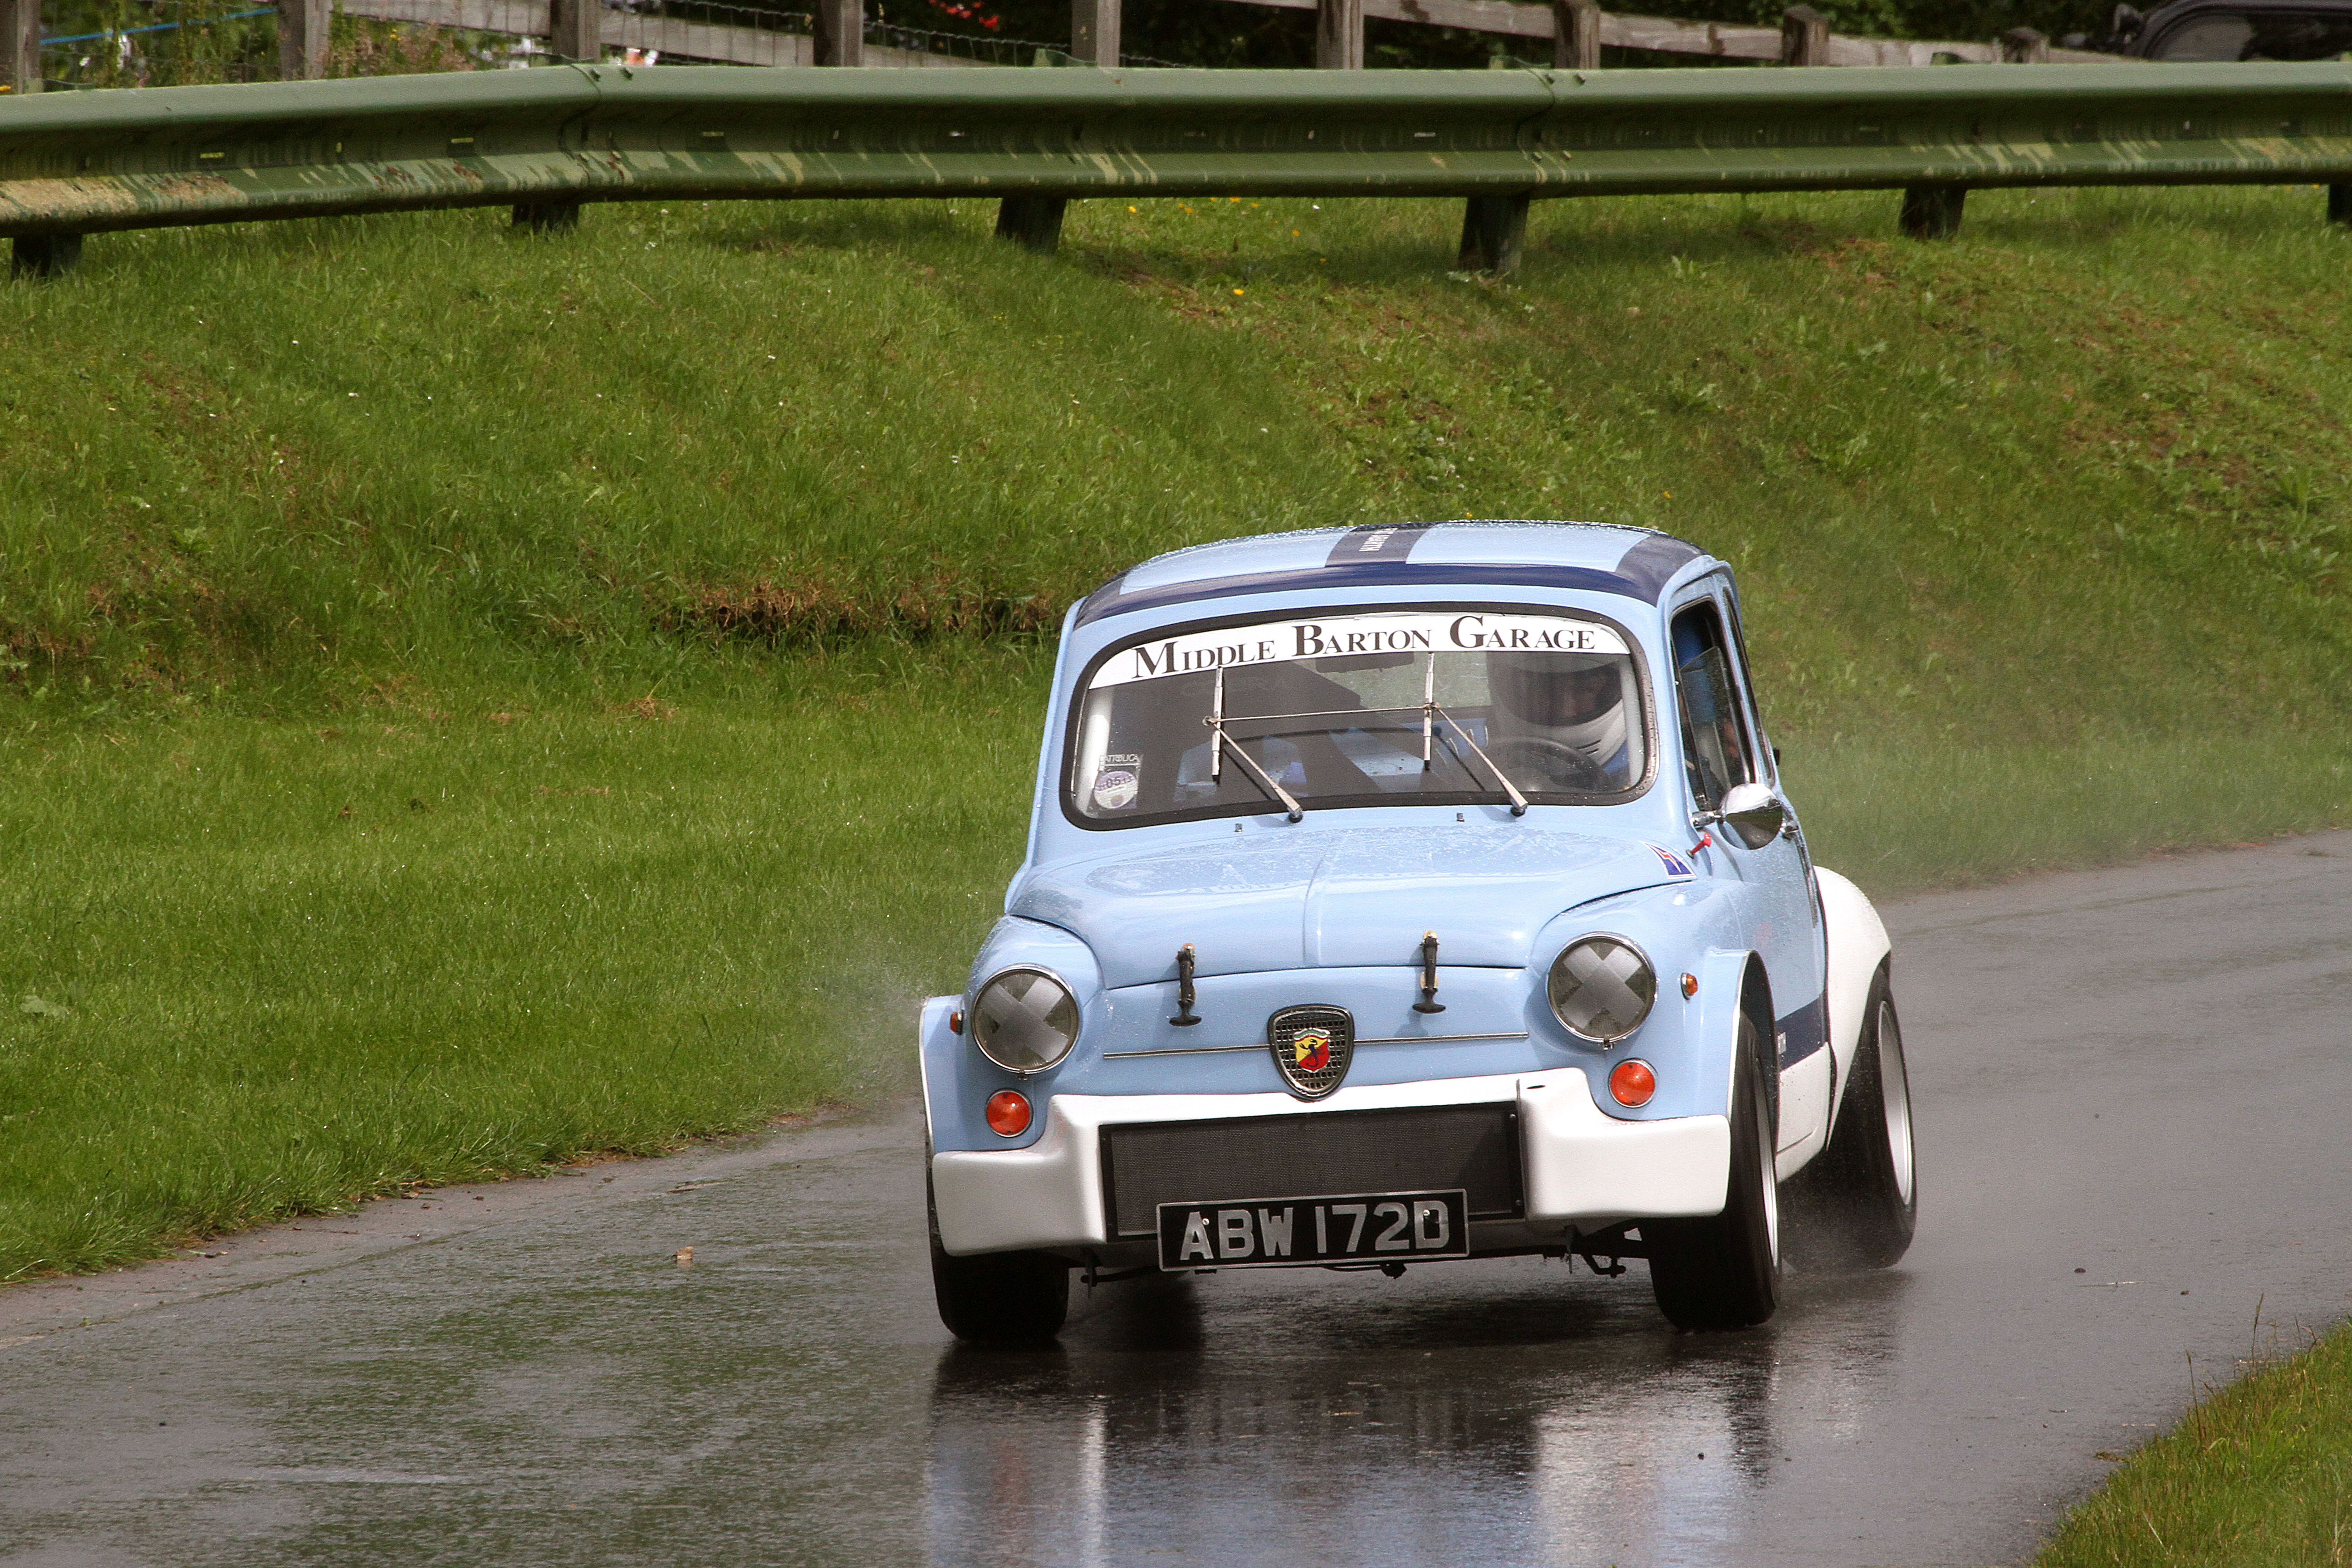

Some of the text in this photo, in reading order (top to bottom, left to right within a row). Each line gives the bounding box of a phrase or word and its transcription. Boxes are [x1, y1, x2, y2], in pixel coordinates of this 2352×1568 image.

[1132, 615, 1595, 679] MIDDLE BARTON GARAGE
[1180, 1200, 1449, 1260] ABW 172D
